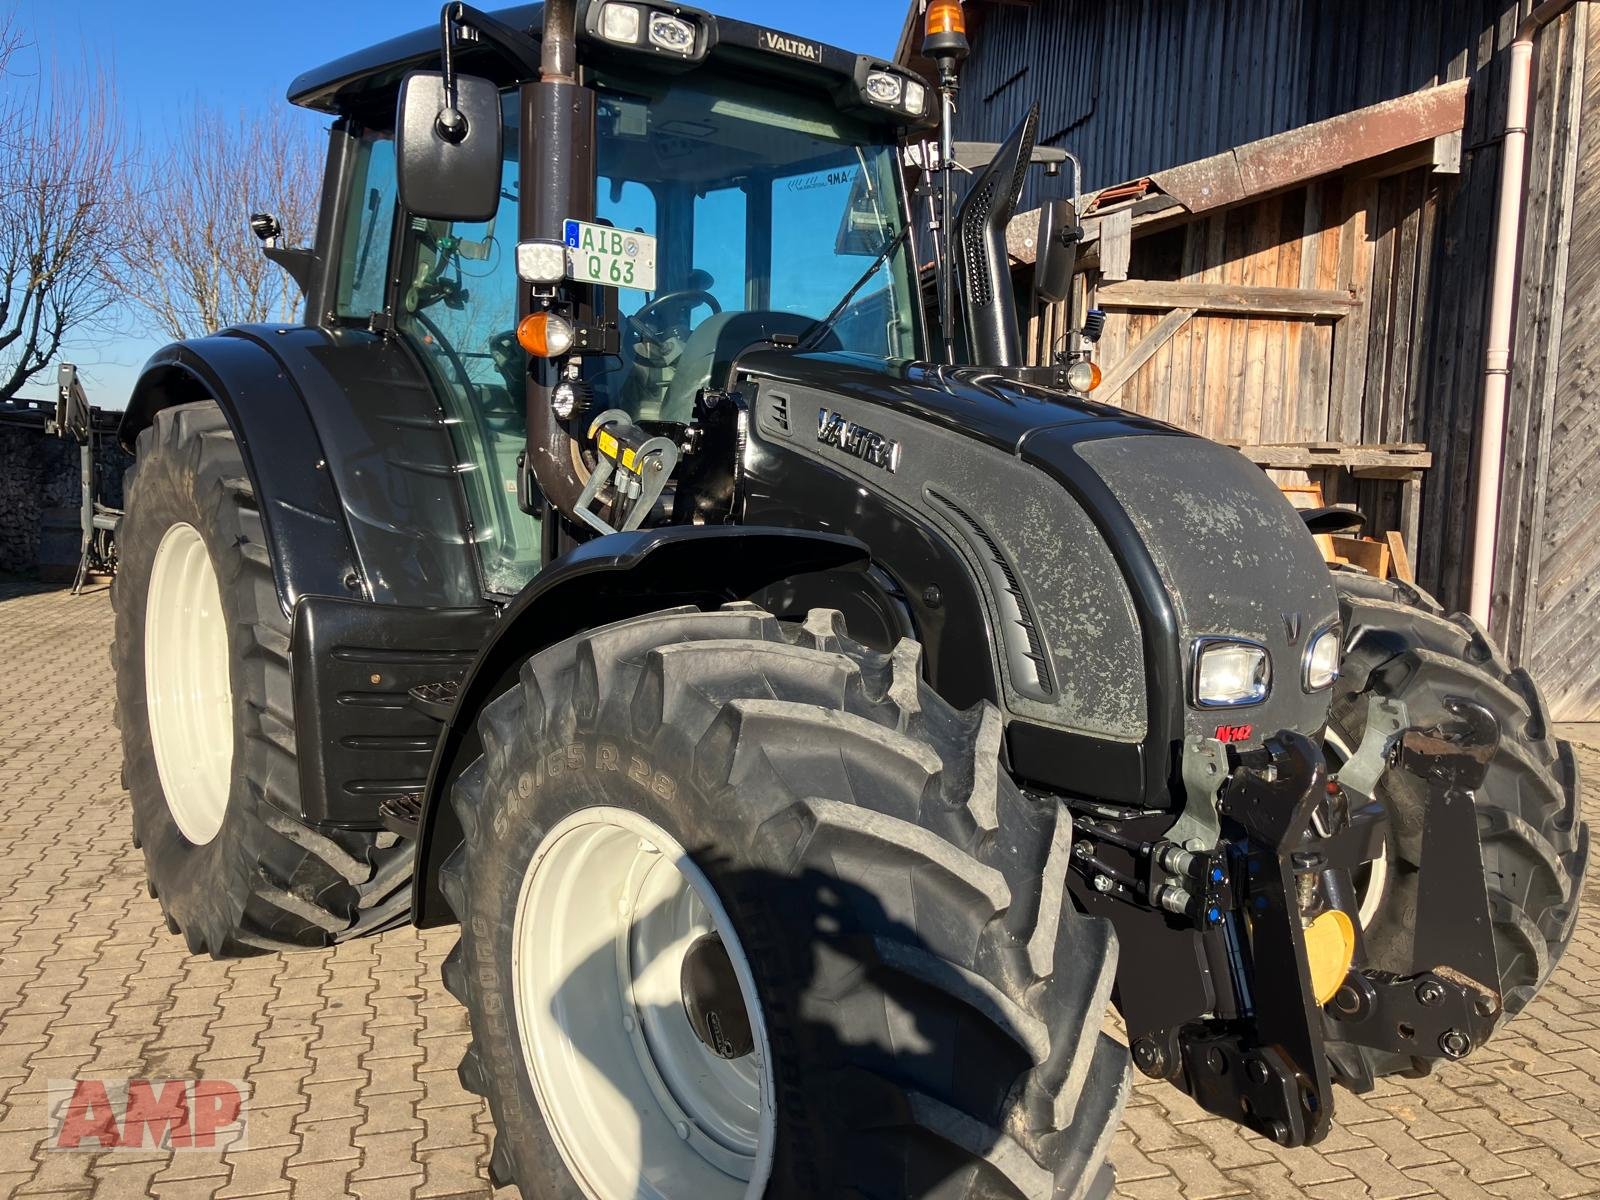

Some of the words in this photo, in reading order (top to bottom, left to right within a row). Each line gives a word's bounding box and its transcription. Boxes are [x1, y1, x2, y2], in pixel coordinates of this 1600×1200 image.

[766, 32, 815, 59] VALTRA
[569, 237, 575, 246] D
[582, 227, 623, 256] AIB
[588, 255, 601, 279] Q
[609, 259, 634, 284] 63
[817, 407, 901, 474] VALTRA
[596, 742, 619, 771] R
[628, 755, 677, 801] 28
